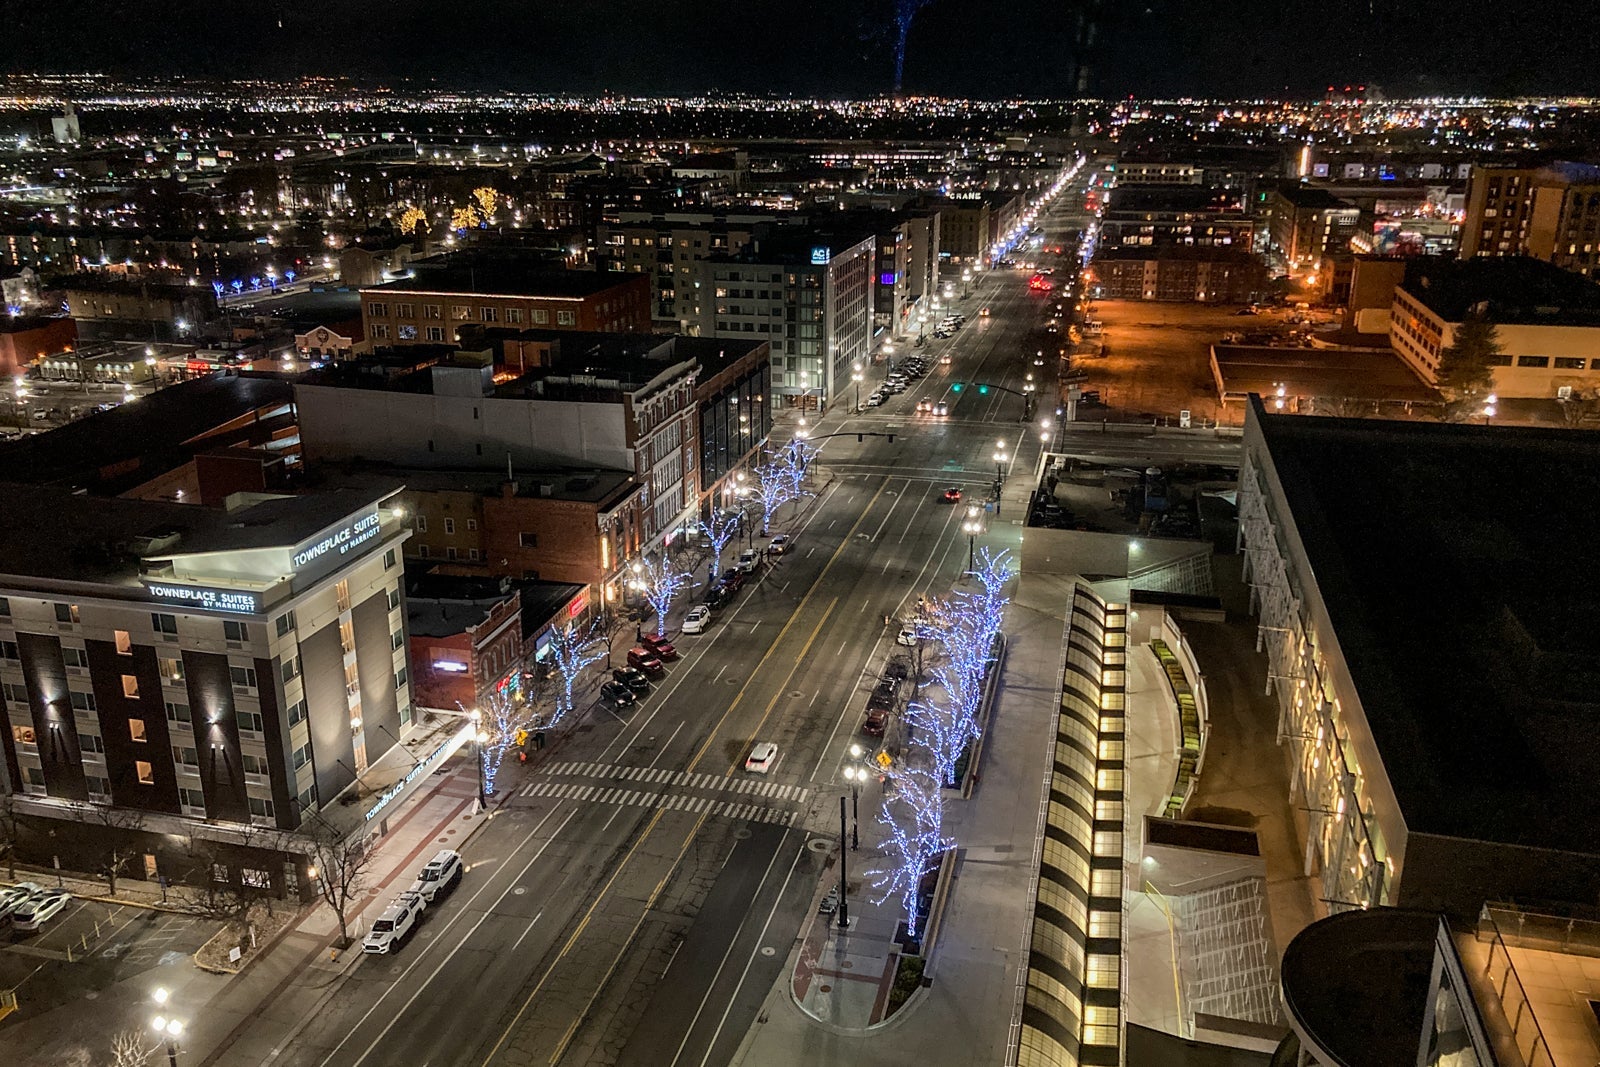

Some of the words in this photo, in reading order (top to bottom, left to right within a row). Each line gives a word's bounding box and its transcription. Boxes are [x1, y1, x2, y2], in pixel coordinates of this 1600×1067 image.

[950, 192, 982, 200] CRANE
[812, 249, 825, 257] AC
[293, 527, 351, 567] TOWNEPLACE
[353, 512, 379, 534] SUITES
[340, 543, 350, 554] BY
[350, 525, 380, 549] MARRIOTT
[149, 585, 216, 601] TOWNEPLACE
[221, 593, 255, 605] SUITES
[215, 601, 255, 611] MARRIOTT
